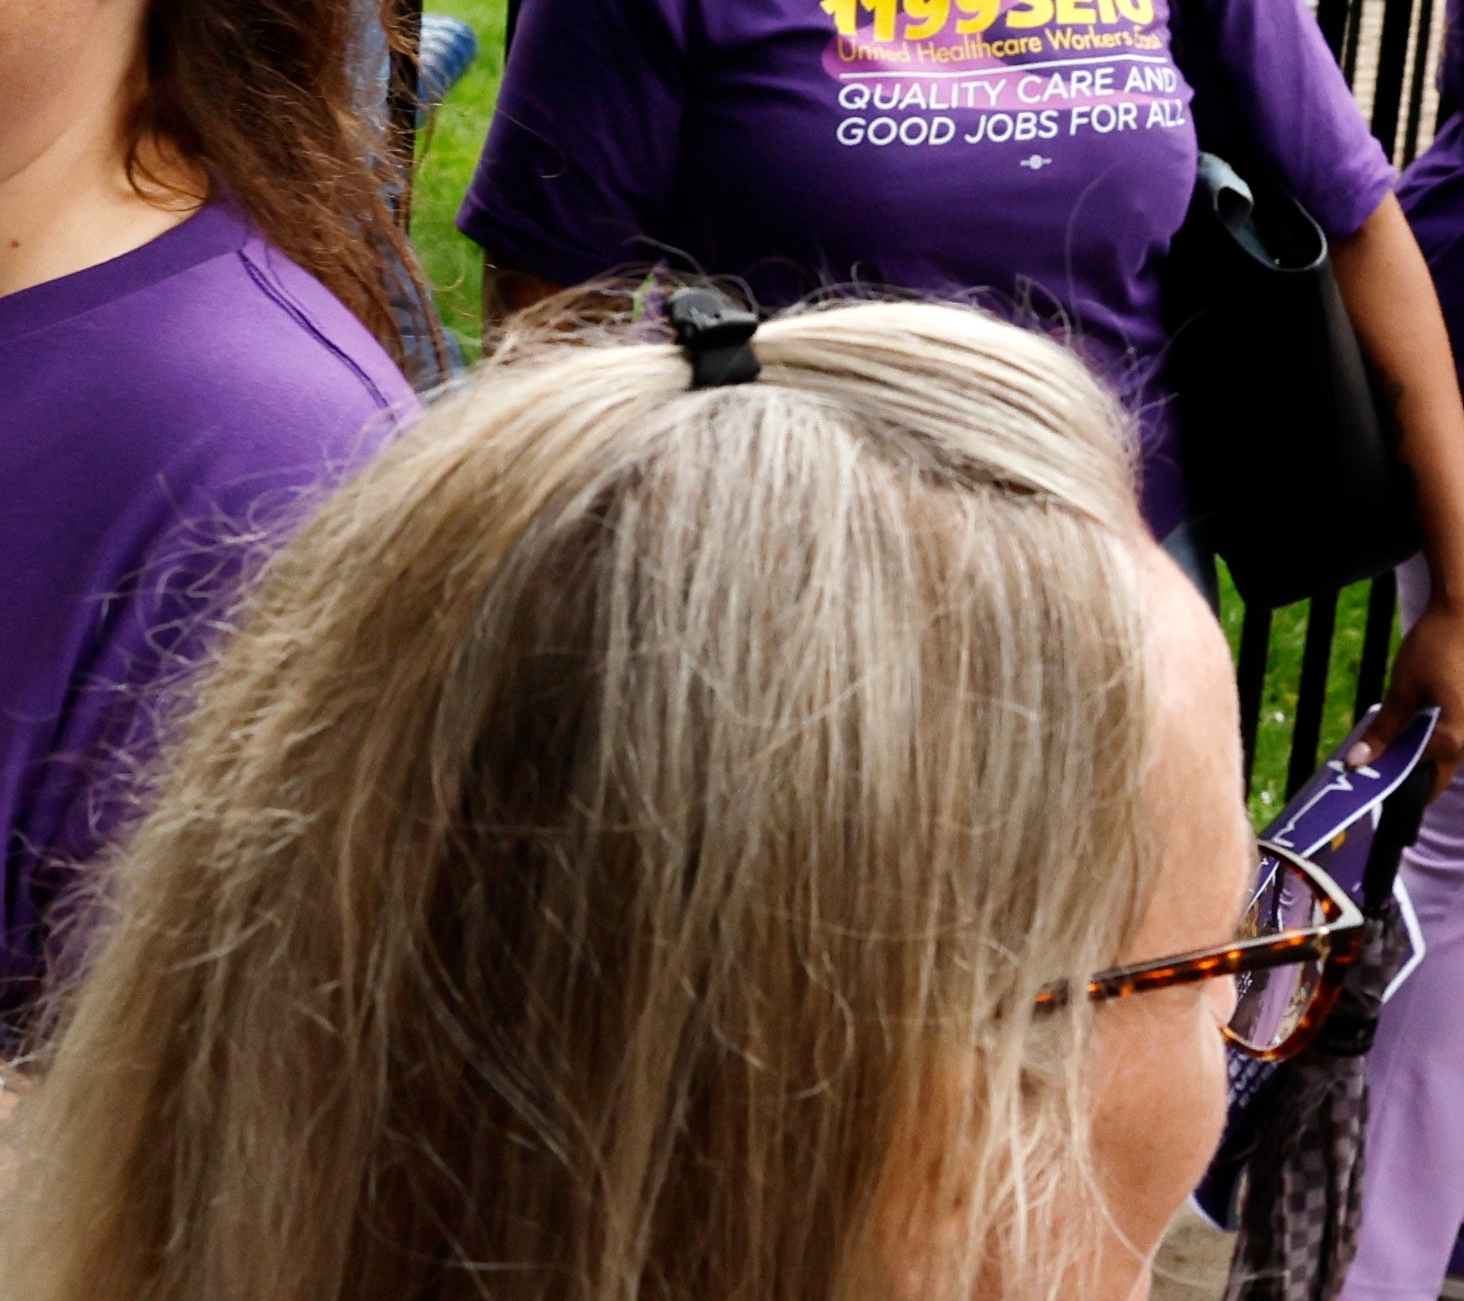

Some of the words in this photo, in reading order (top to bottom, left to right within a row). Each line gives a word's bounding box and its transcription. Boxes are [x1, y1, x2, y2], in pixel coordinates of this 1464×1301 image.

[917, 32, 1043, 64] Healthcare
[1043, 26, 1132, 52] Workers
[838, 77, 1007, 111] QUALITY
[1016, 68, 1114, 104] CARE
[1123, 65, 1178, 94] AND
[836, 115, 956, 146] GOOD
[964, 109, 1060, 145] JOBS
[1068, 103, 1137, 136] FOR
[1145, 98, 1187, 130] ALL
